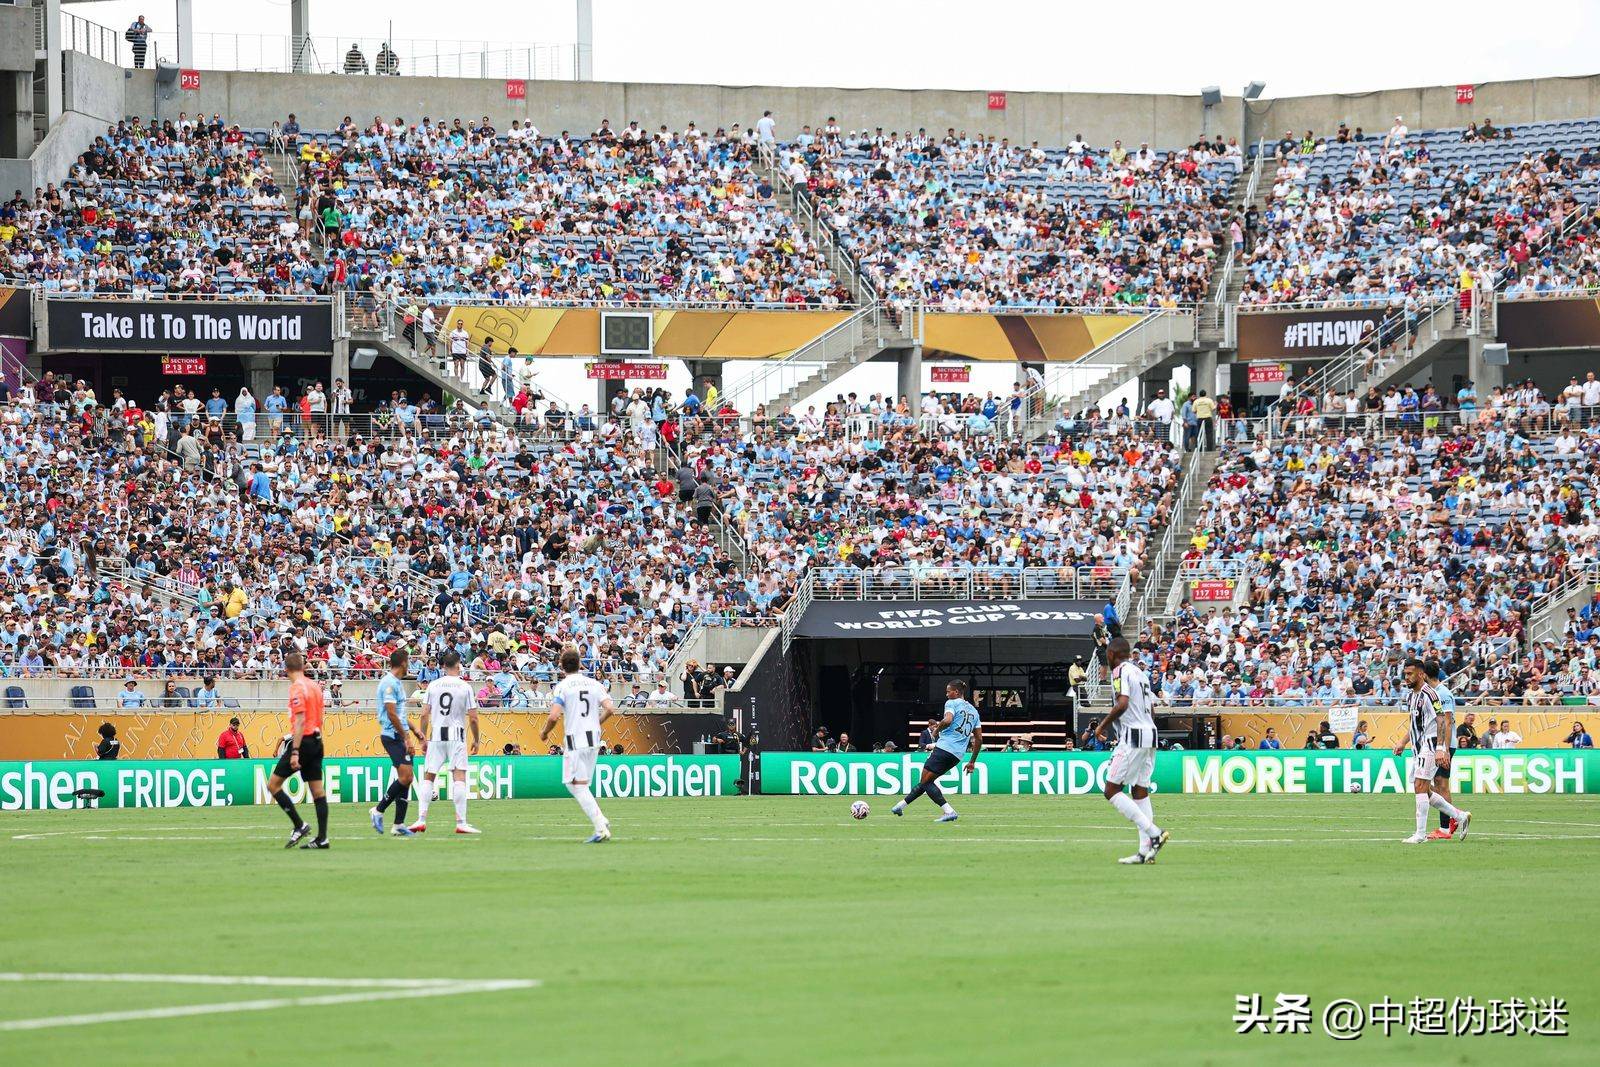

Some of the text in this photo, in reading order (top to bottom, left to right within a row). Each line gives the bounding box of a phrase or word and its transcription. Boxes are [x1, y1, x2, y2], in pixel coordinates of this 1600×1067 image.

[182, 75, 198, 85] P15
[508, 85, 524, 95] P16
[990, 96, 1004, 106] P17
[1458, 89, 1472, 99] P18
[82, 312, 302, 340] Take It To The World
[834, 619, 943, 630] WORLD
[948, 613, 1006, 625] CUP
[878, 604, 1020, 619] FIFA CLUB
[440, 692, 454, 716] 9
[580, 690, 590, 718] 5
[955, 710, 974, 737] 25
[1, 762, 98, 810] shen
[118, 768, 233, 808] FRIDGE,
[596, 757, 721, 798] Ronshen
[1182, 756, 1306, 794] MORE
[1450, 755, 1584, 794] FRESH
